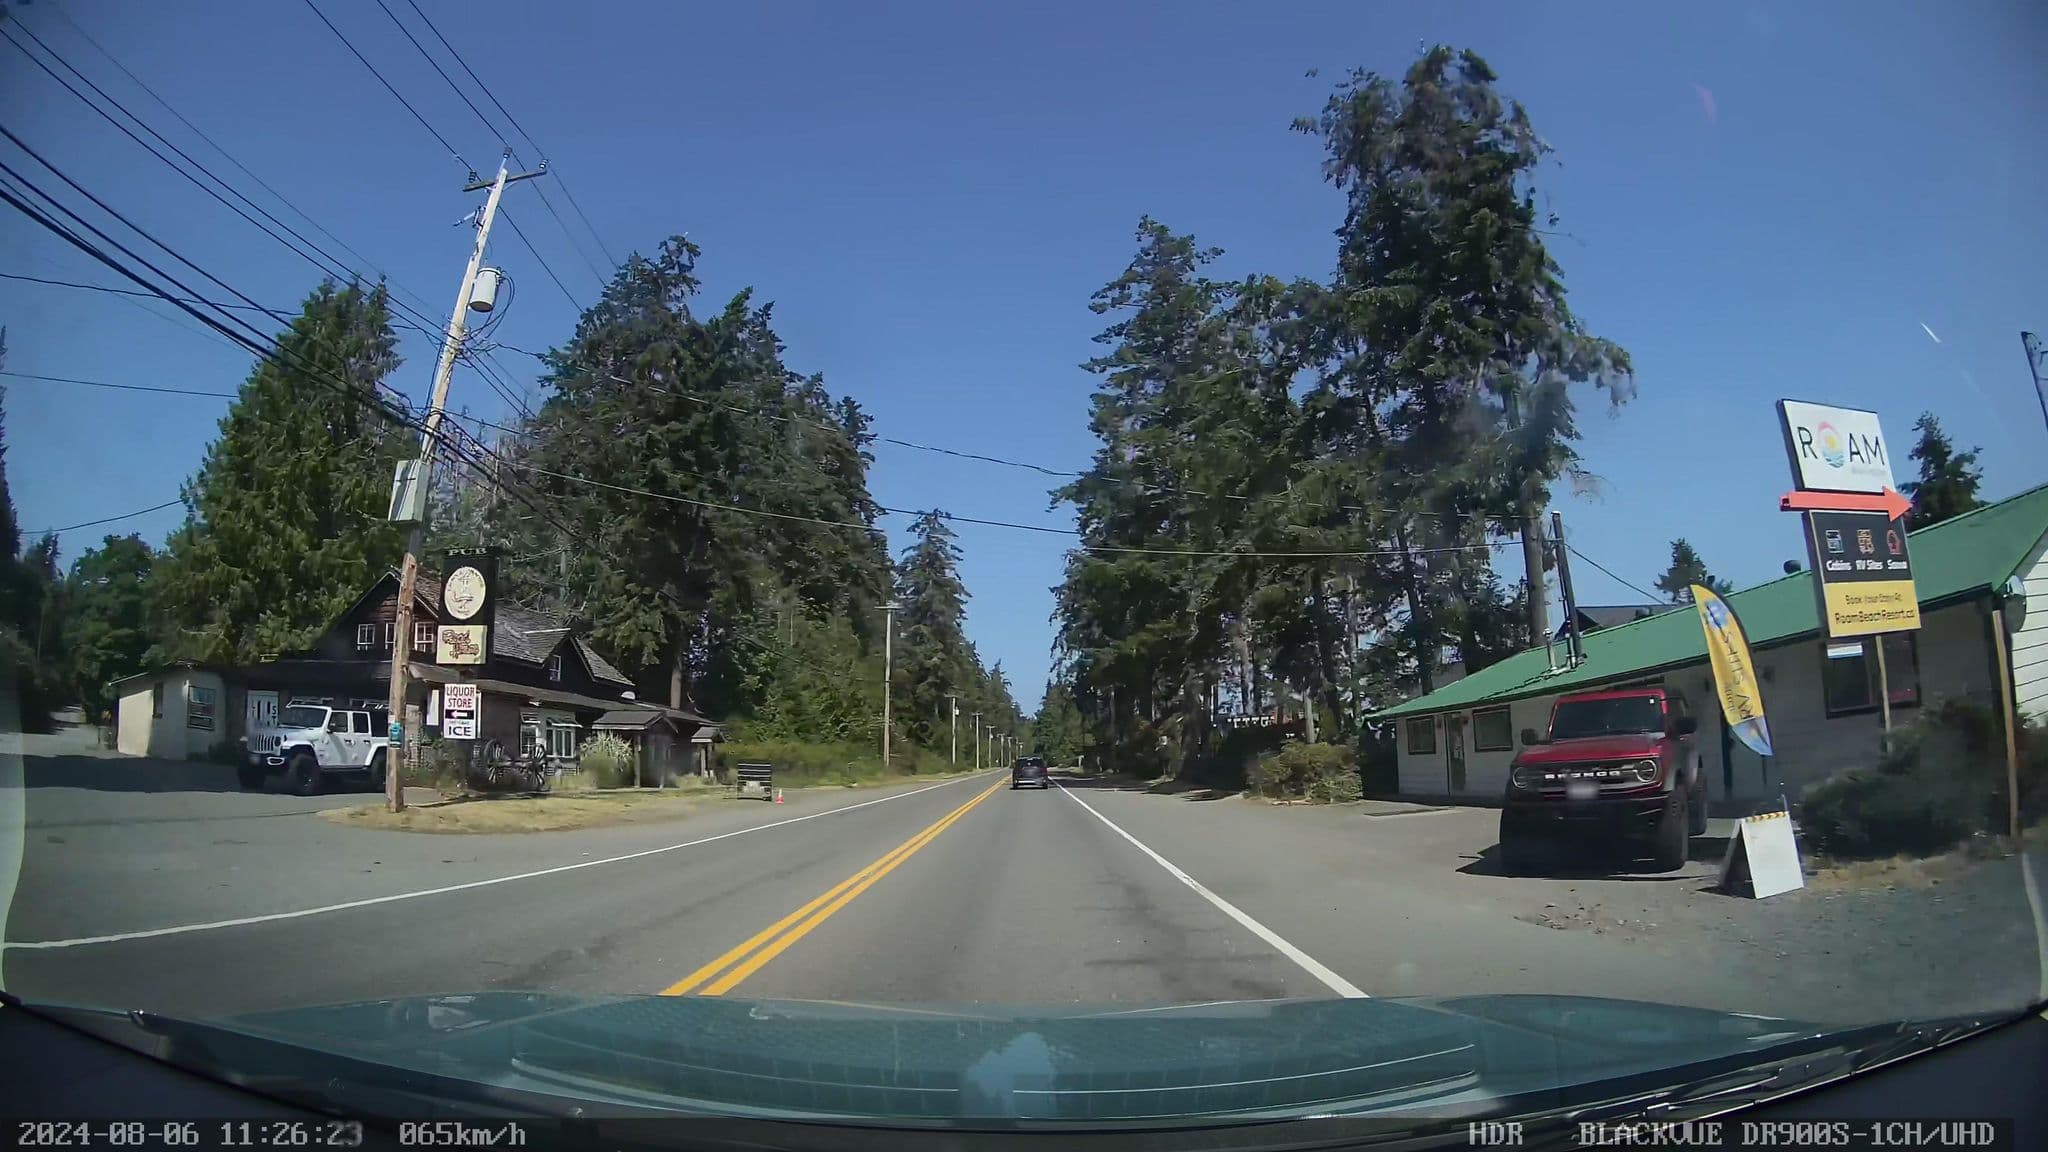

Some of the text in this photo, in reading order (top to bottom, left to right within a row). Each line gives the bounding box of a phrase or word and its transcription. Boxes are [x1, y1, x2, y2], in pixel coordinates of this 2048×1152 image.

[448, 547, 487, 556] PUB
[446, 686, 475, 698] LIQUOR
[448, 698, 472, 708] STORE
[449, 726, 472, 737] ICE
